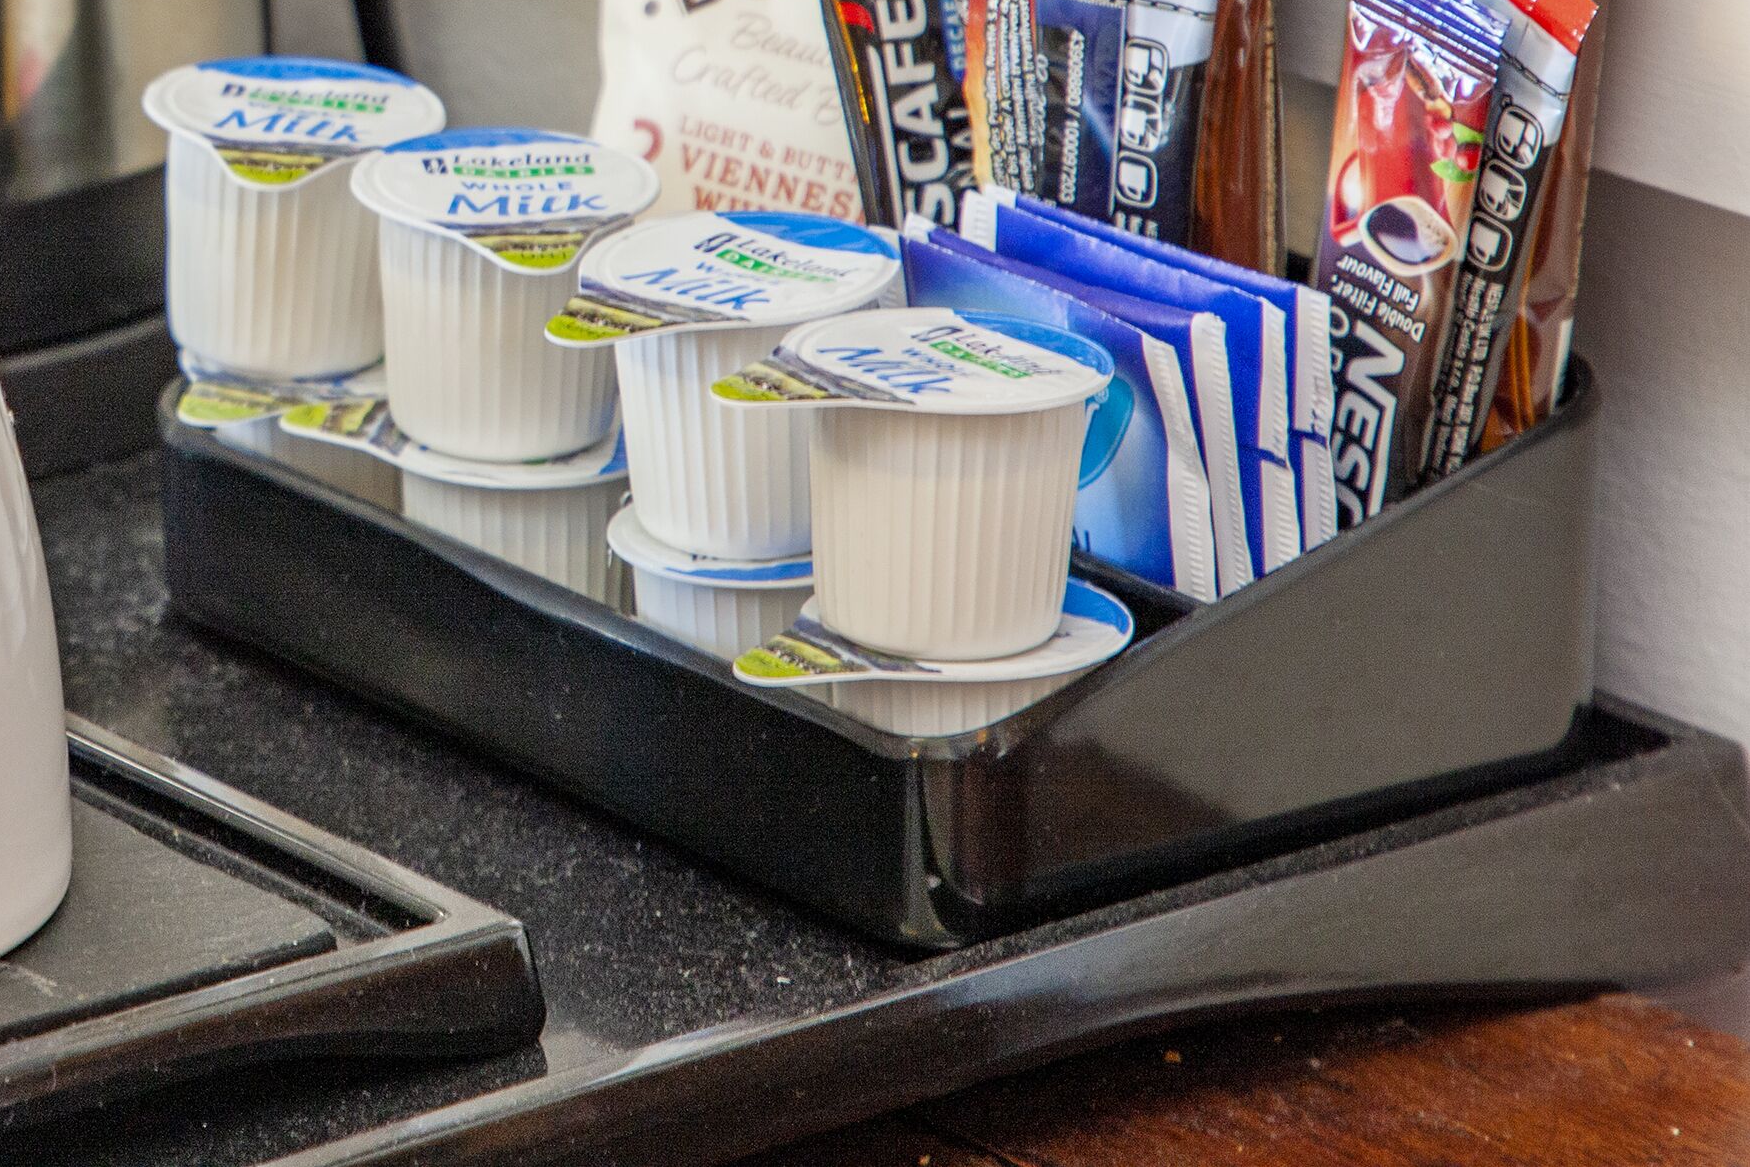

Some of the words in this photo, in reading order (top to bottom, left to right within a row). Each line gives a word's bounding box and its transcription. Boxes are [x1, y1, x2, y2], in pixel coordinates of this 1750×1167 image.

[673, 46, 806, 110] Crafted
[213, 109, 360, 142] Milk
[680, 115, 752, 154] LIGHT
[758, 138, 776, 160] &
[453, 153, 592, 167] Lakeland
[447, 194, 608, 217] Milk
[461, 181, 573, 192] WHOLE
[736, 239, 856, 277] Lakeland
[1337, 254, 1394, 297] Flavour
[620, 268, 770, 310] Milk
[1392, 281, 1419, 313] Full
[1378, 302, 1426, 343] Double
